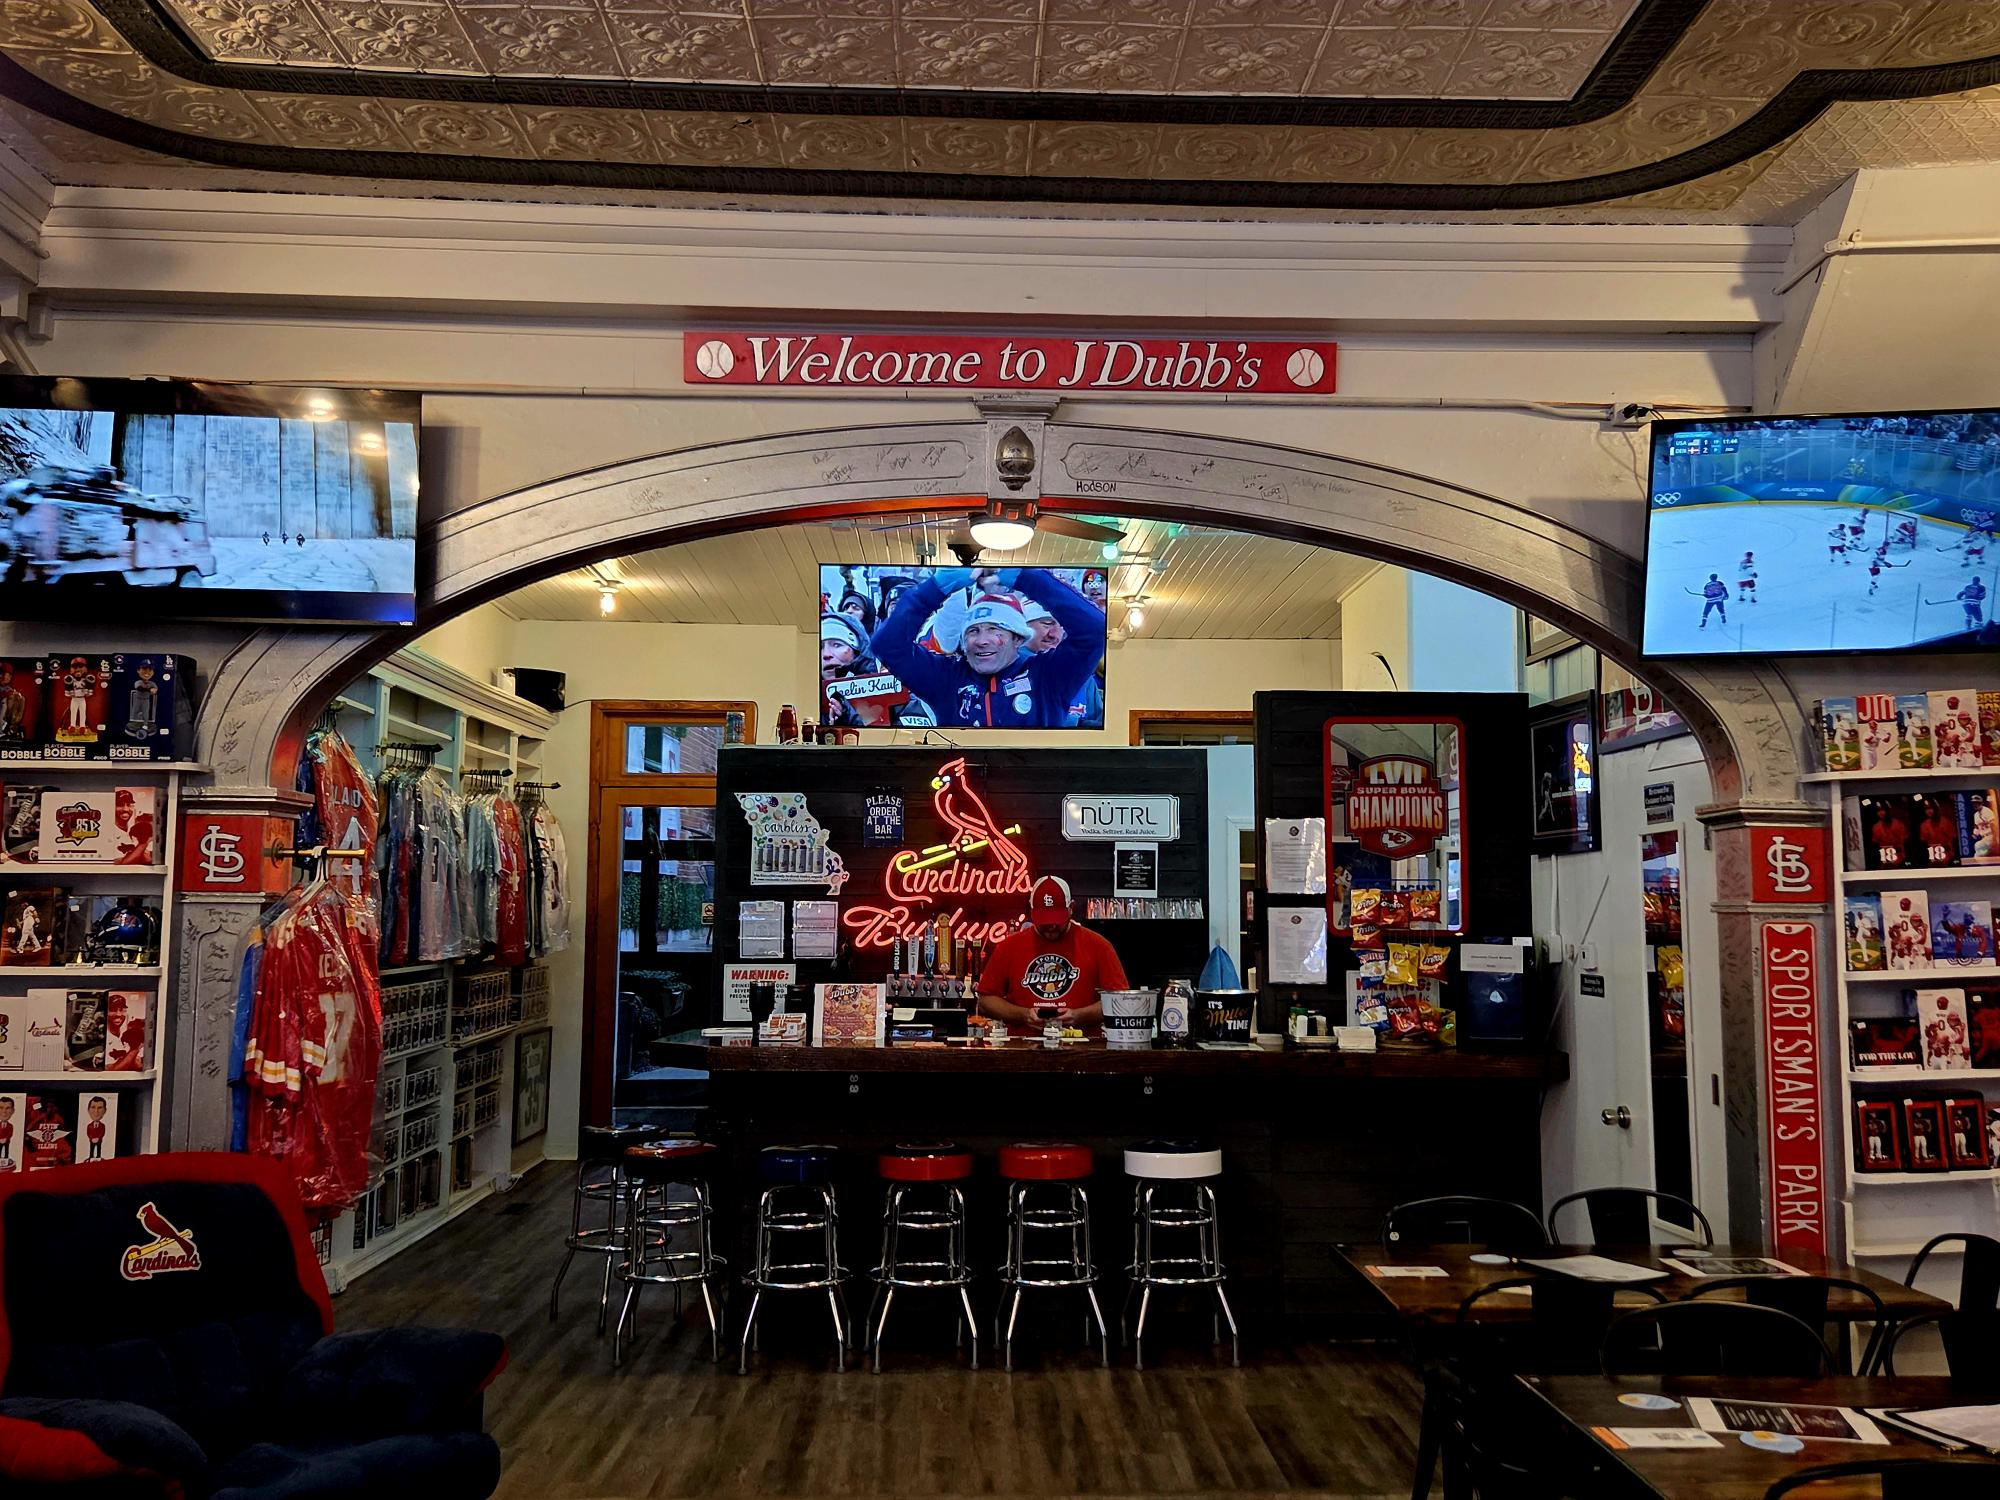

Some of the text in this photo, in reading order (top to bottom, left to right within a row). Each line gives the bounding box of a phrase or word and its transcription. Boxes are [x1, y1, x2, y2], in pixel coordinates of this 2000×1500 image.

[746, 336, 982, 386] Welcome
[999, 342, 1046, 383] to
[903, 716, 930, 726] VISA
[1, 750, 42, 760] BOBBLE
[44, 748, 86, 758] BOBBLE
[109, 748, 151, 758] BOBBLE
[1369, 761, 1424, 785] LVII
[1401, 786, 1435, 794] BOWL
[866, 794, 902, 808] PLEASE
[869, 807, 897, 816] ORDER
[1349, 796, 1444, 830] CHAMPIONS
[866, 816, 901, 825] AT THE
[764, 818, 811, 835] carbliss
[875, 825, 892, 834] BAR
[1878, 846, 1898, 861] 18
[1927, 845, 1946, 861] 18
[886, 850, 1033, 903] Cardinals
[894, 954, 902, 970] BUD
[1035, 956, 1063, 964] SPORTS
[731, 969, 790, 980] WARNING:
[1208, 1000, 1223, 1010] IT'S
[1115, 1018, 1147, 1027] FLIGHT
[1226, 1019, 1249, 1030] TIME
[1878, 1052, 1897, 1061] THE
[1770, 946, 1820, 1236] SPORTSMAN'S PARK
[122, 1246, 202, 1279] Cardinals
